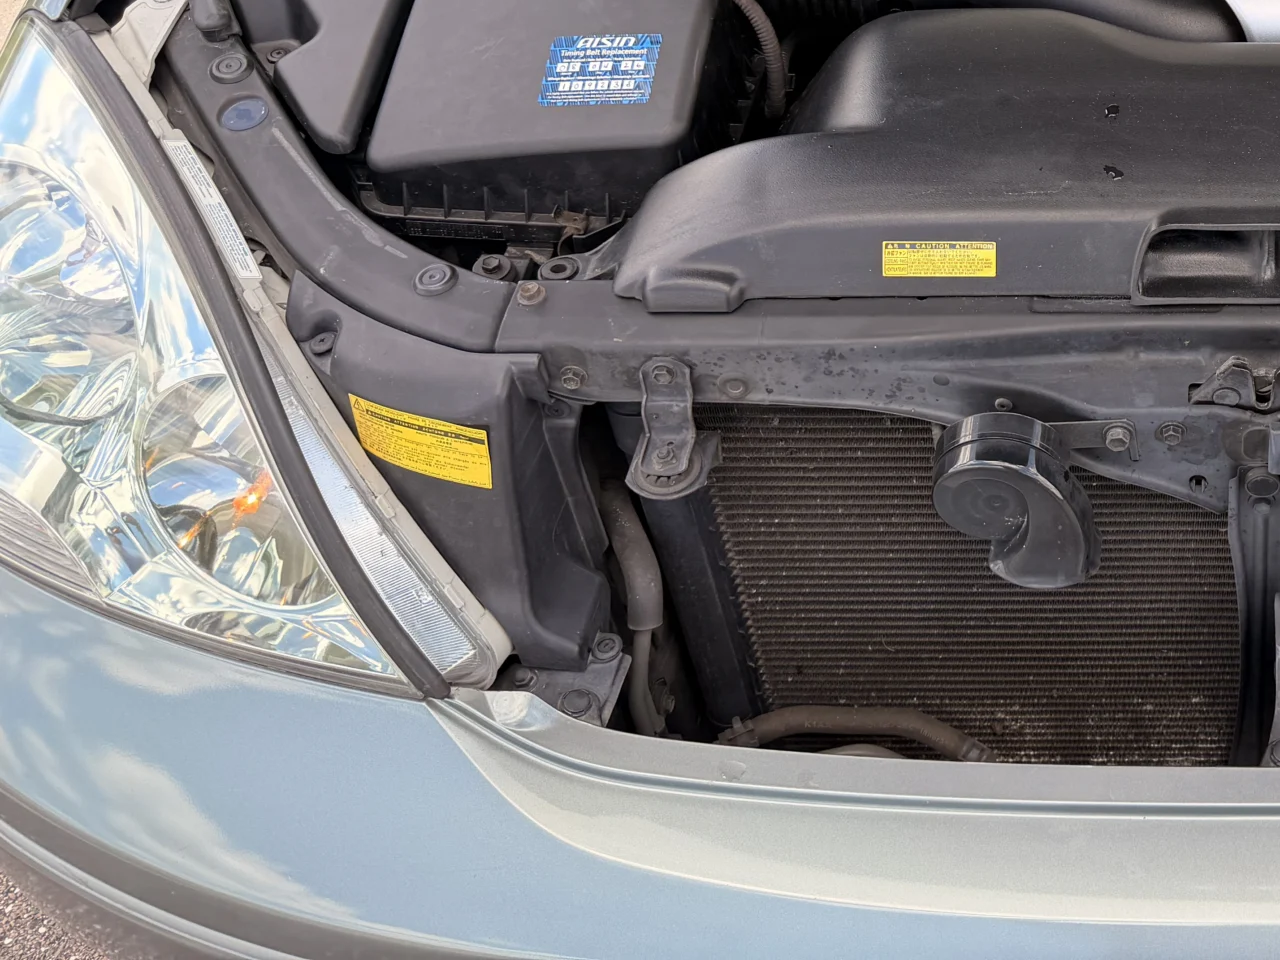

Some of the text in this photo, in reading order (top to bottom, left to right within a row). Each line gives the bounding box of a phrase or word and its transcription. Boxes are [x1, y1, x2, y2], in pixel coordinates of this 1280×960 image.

[577, 36, 636, 48] AISIN
[561, 47, 648, 57] Timing Belt Replacement
